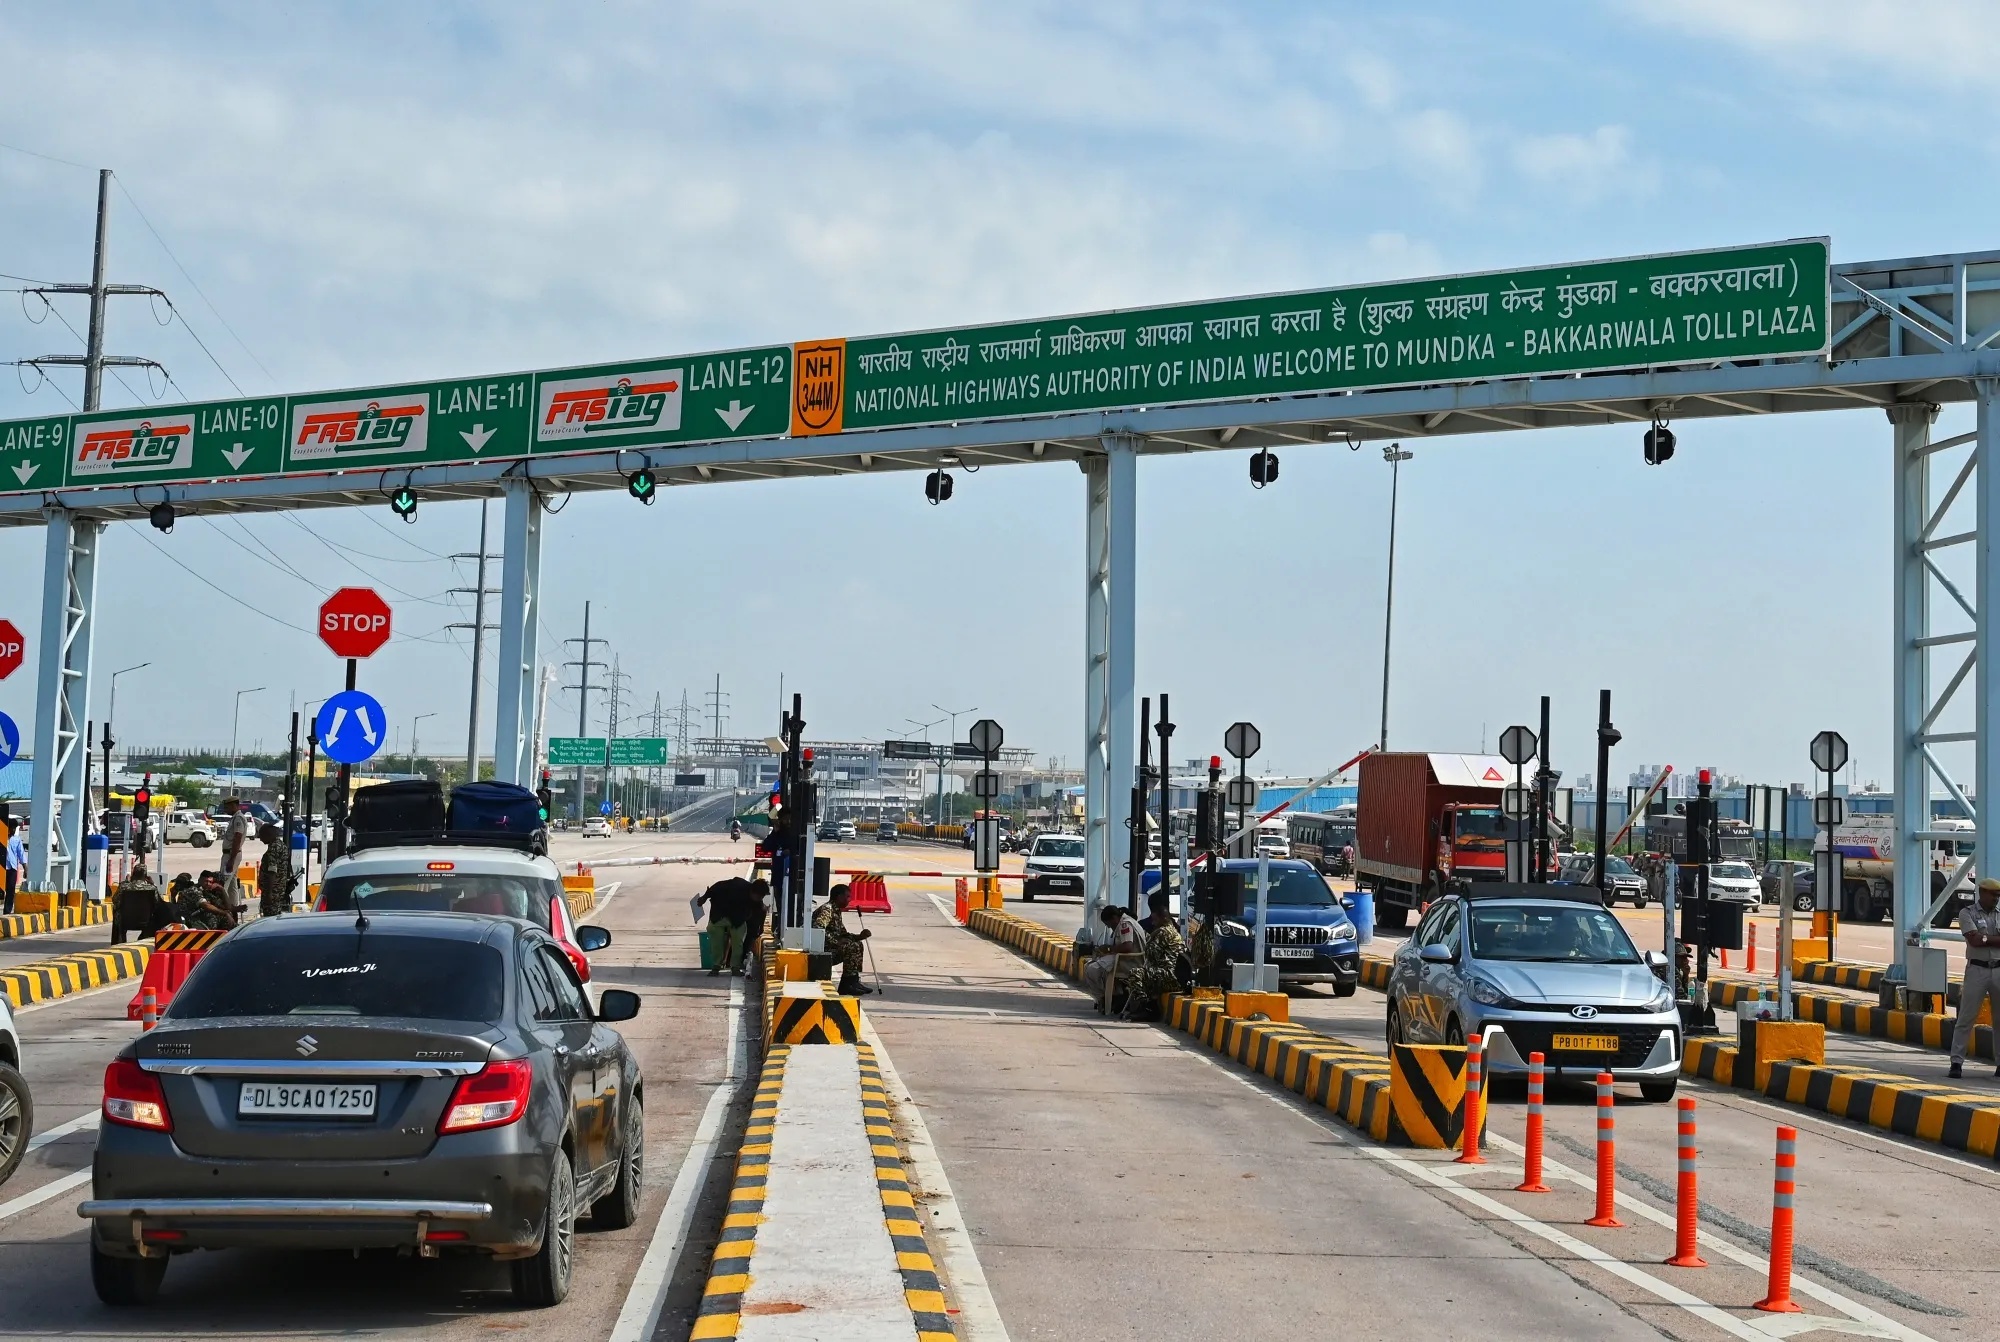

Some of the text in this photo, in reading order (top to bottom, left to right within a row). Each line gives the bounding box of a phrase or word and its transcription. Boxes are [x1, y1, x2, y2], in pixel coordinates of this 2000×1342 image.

[859, 343, 912, 374] भारतीय
[922, 337, 970, 373] राष्ट्रीय
[979, 329, 1042, 363] राजमार्ग
[1050, 325, 1126, 356] प्राधिकरण
[1136, 321, 1194, 347] आपका
[1203, 314, 1260, 341] स्वागत
[1271, 308, 1321, 335] करता
[1332, 298, 1346, 332] है
[1359, 297, 1414, 336] (शुल्क
[1425, 286, 1489, 320] संग्रहण
[1501, 280, 1546, 313] केन्द्र
[1556, 273, 1618, 319] मुंडका
[689, 355, 784, 391] LANE-12
[805, 356, 832, 378] NH
[855, 383, 939, 413] NATIONAL
[945, 375, 1040, 406] HIGHWAYS
[1046, 364, 1152, 397] AUTHORITY
[1157, 362, 1183, 387] OF
[1190, 356, 1246, 384] INDIA
[1254, 346, 1356, 379] WELCOME
[1363, 343, 1389, 369] TO
[1398, 334, 1495, 367] MUNDKA
[1525, 316, 1675, 356] BAKKARWALA
[1682, 312, 1737, 342] TOLL
[1743, 305, 1816, 338] PLAZA
[437, 381, 525, 415] LANE-11
[802, 381, 834, 412] 344M
[202, 404, 279, 434] LANE-10
[0, 423, 63, 451] ANE-9
[324, 613, 387, 632] STOP
[302, 966, 360, 978] Verma
[1559, 1036, 1570, 1047] PB
[254, 1088, 374, 1108] DL9CAQ1250
